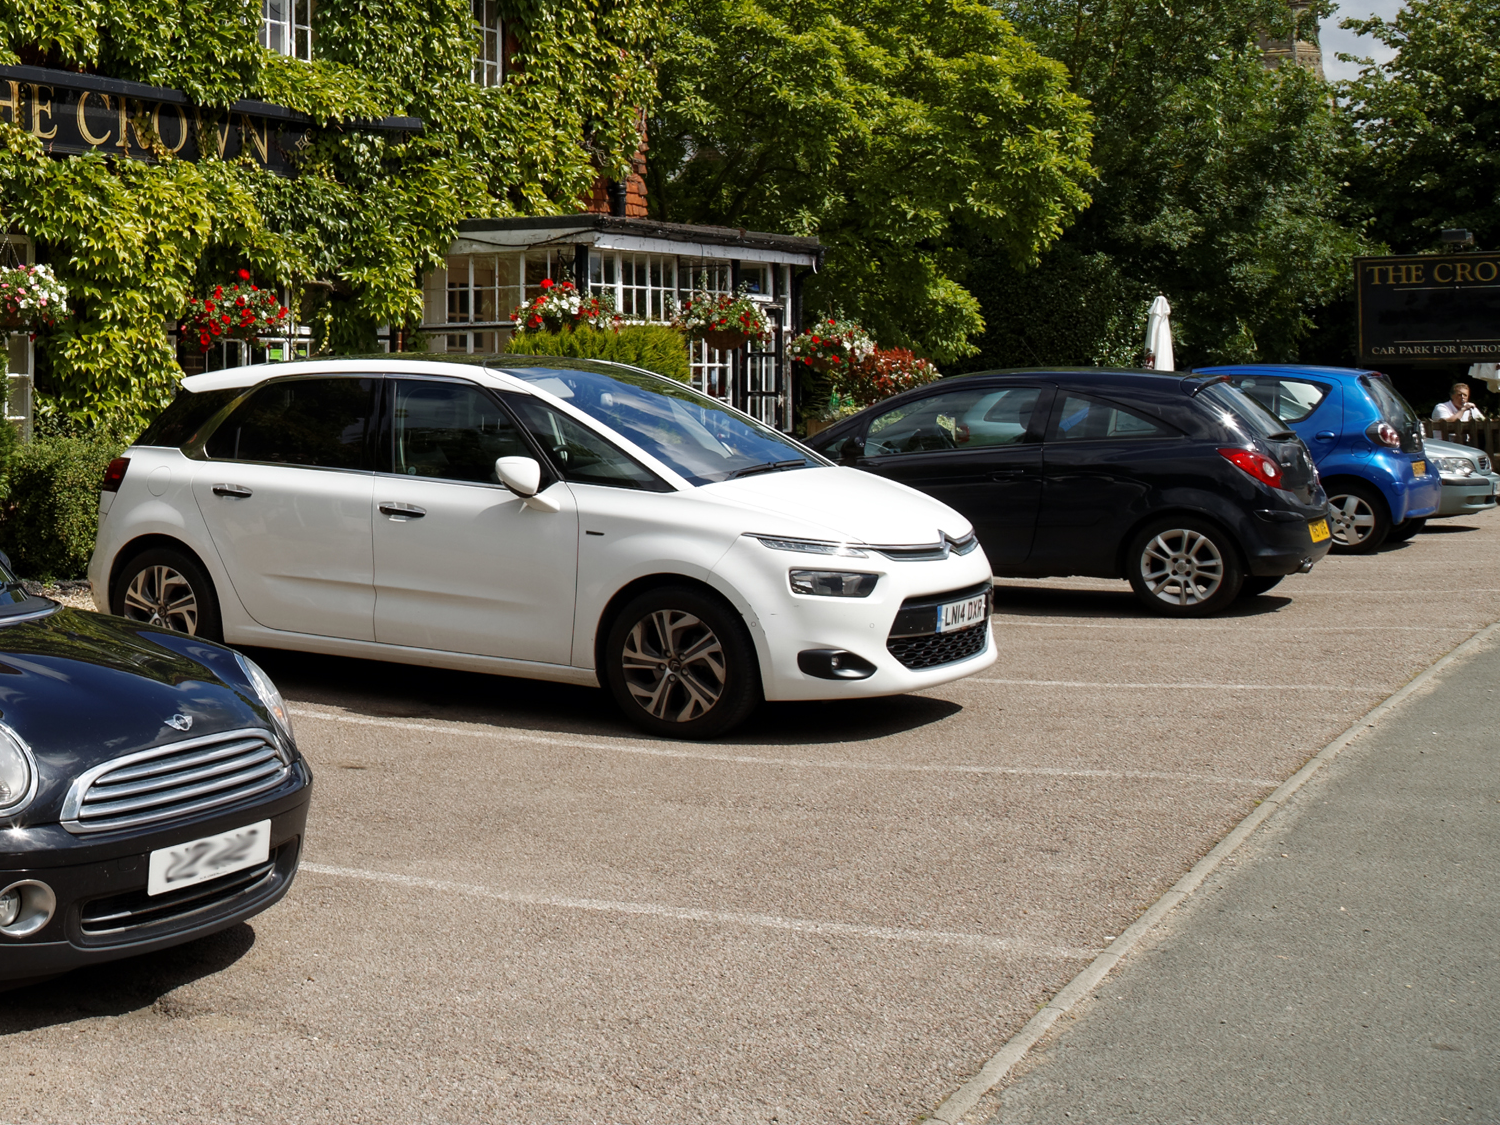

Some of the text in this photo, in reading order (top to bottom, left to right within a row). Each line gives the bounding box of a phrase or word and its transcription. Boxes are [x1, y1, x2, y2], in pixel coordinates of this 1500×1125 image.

[1366, 261, 1500, 285] THE CRO
[1371, 346, 1396, 355] CAR
[1399, 346, 1430, 354] PARK
[1433, 345, 1457, 354] FOR
[945, 598, 982, 627] LN14 DXR
